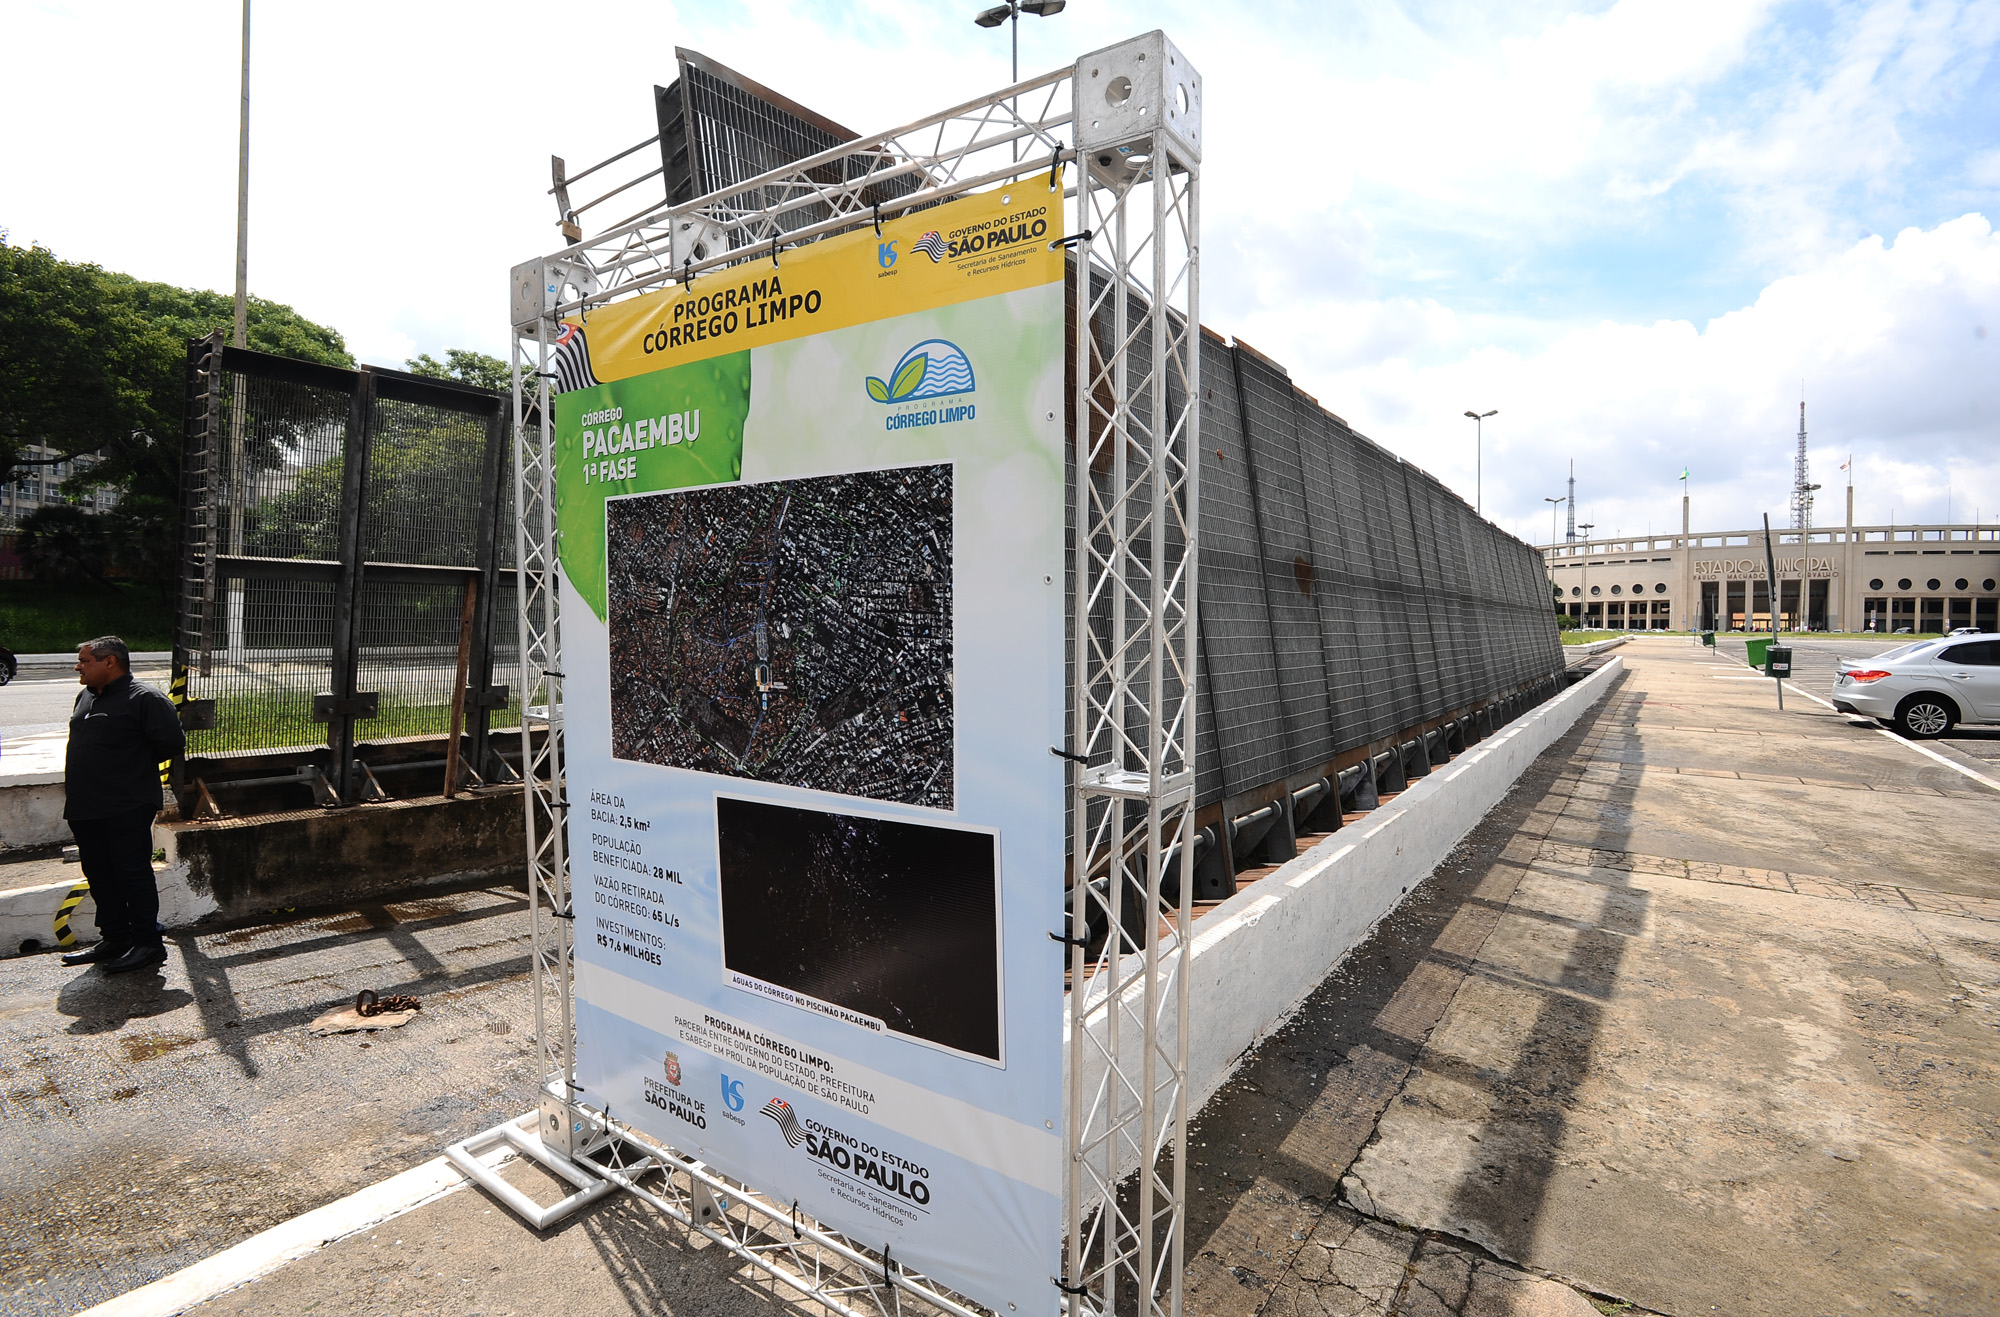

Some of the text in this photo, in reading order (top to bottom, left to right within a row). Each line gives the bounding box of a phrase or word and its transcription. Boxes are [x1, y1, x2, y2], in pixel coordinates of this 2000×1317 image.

[948, 219, 1047, 258] SÃO PAULO
[949, 206, 1047, 239] GOVERNO DO ESTADO
[878, 269, 898, 279] sabesp
[957, 259, 987, 271] Secretaria
[998, 246, 1037, 261] Saneamento
[973, 265, 1000, 275] Recursos
[1001, 258, 1026, 269] Hídricos
[673, 275, 783, 324] PROGRAMA
[643, 289, 822, 355] CÓRREGO LIMPO
[581, 407, 623, 427] CÓRREGO
[886, 405, 975, 431] CÓRREGO LIMPO
[898, 398, 963, 412] PROGRAMA
[582, 410, 701, 460] PACAEMBU
[600, 457, 638, 482] FASE
[590, 789, 626, 809] ÁREA DA
[592, 809, 618, 825] BACIA:
[620, 815, 632, 829] 2,5
[593, 833, 642, 856] POPULAÇÃO
[593, 851, 683, 885] BENEFICIADA: 28 MIL
[594, 874, 665, 905] VAZÃO RETIRADA
[595, 892, 680, 928] DO CÓRREGO: 65 L/s
[596, 917, 666, 950] INVESTIMENTOS:
[597, 934, 662, 966] R$ 7,6 MILHÕES
[733, 974, 881, 1032] ÁGUAS DO CÓRREGO NO PISCINÃO PACAEMBU
[674, 1016, 876, 1104] PARCERIA ENTRE GOVERNO DO ESTADO, PREFEITURA
[704, 1014, 834, 1074] PROGRAMA CÓRREGO LIMPO:
[680, 1030, 869, 1115] E SABESP EM PROL DA POPULAÇÃO DE SÃO PAULO
[644, 1076, 706, 1114] PREFEITURA DE
[644, 1090, 706, 1130] SÃO PAULO
[722, 1110, 746, 1127] sabesp
[805, 1119, 930, 1179] GOVERNO DO ESTADO
[806, 1133, 930, 1205] SÃO PAULO
[818, 1168, 918, 1221] Secretaria de Saneamento
[837, 1190, 870, 1214] Recursos
[873, 1207, 904, 1227] Hídricos
